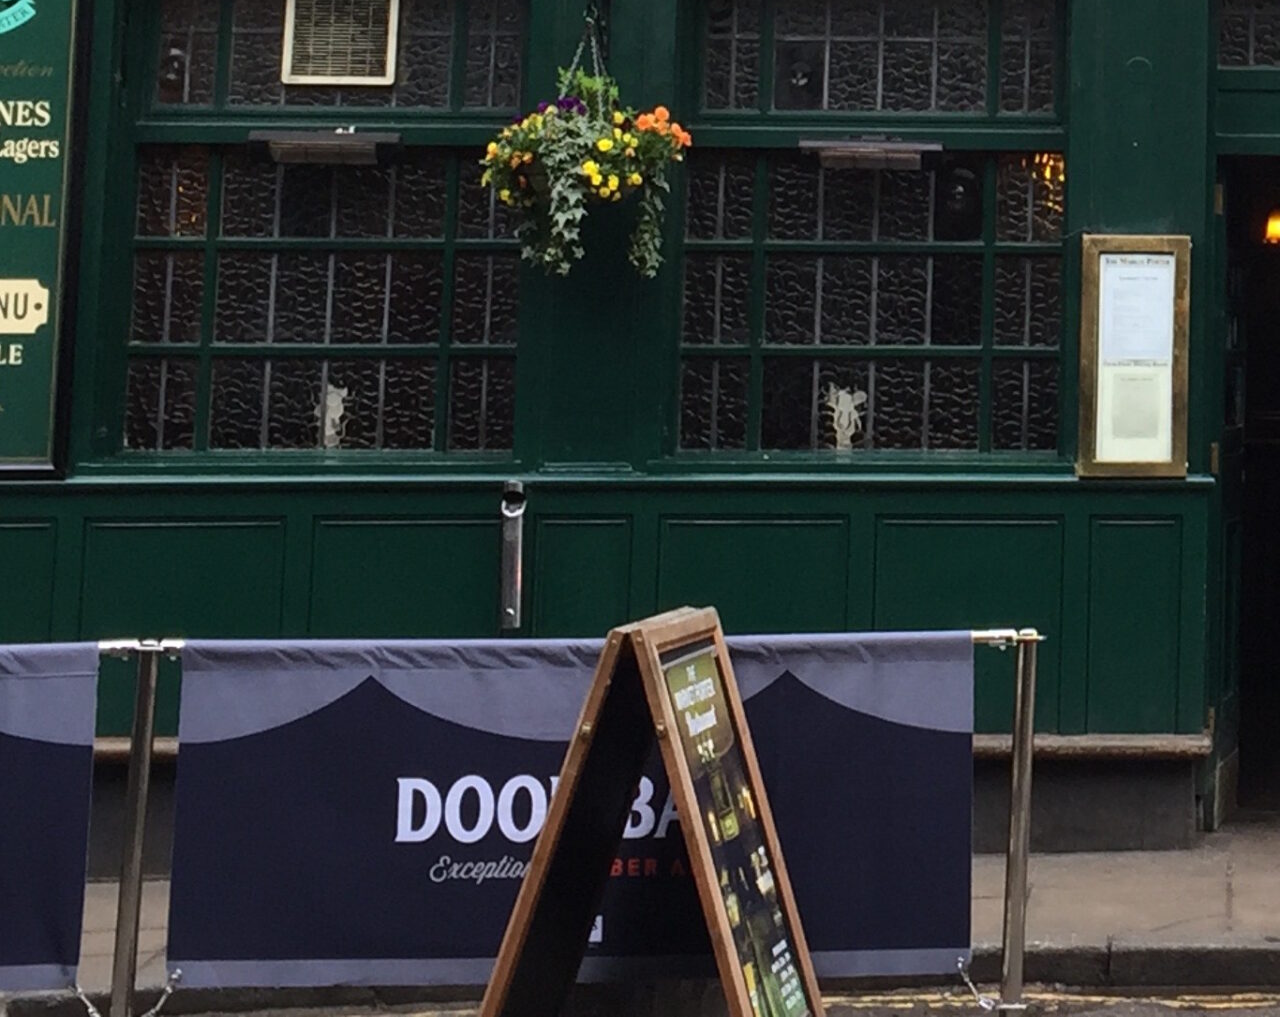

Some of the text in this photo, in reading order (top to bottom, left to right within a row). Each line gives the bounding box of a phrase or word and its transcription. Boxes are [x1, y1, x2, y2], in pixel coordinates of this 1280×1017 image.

[394, 774, 560, 844] DOO
[429, 855, 532, 885] Exceptio
[609, 858, 657, 877] BER
